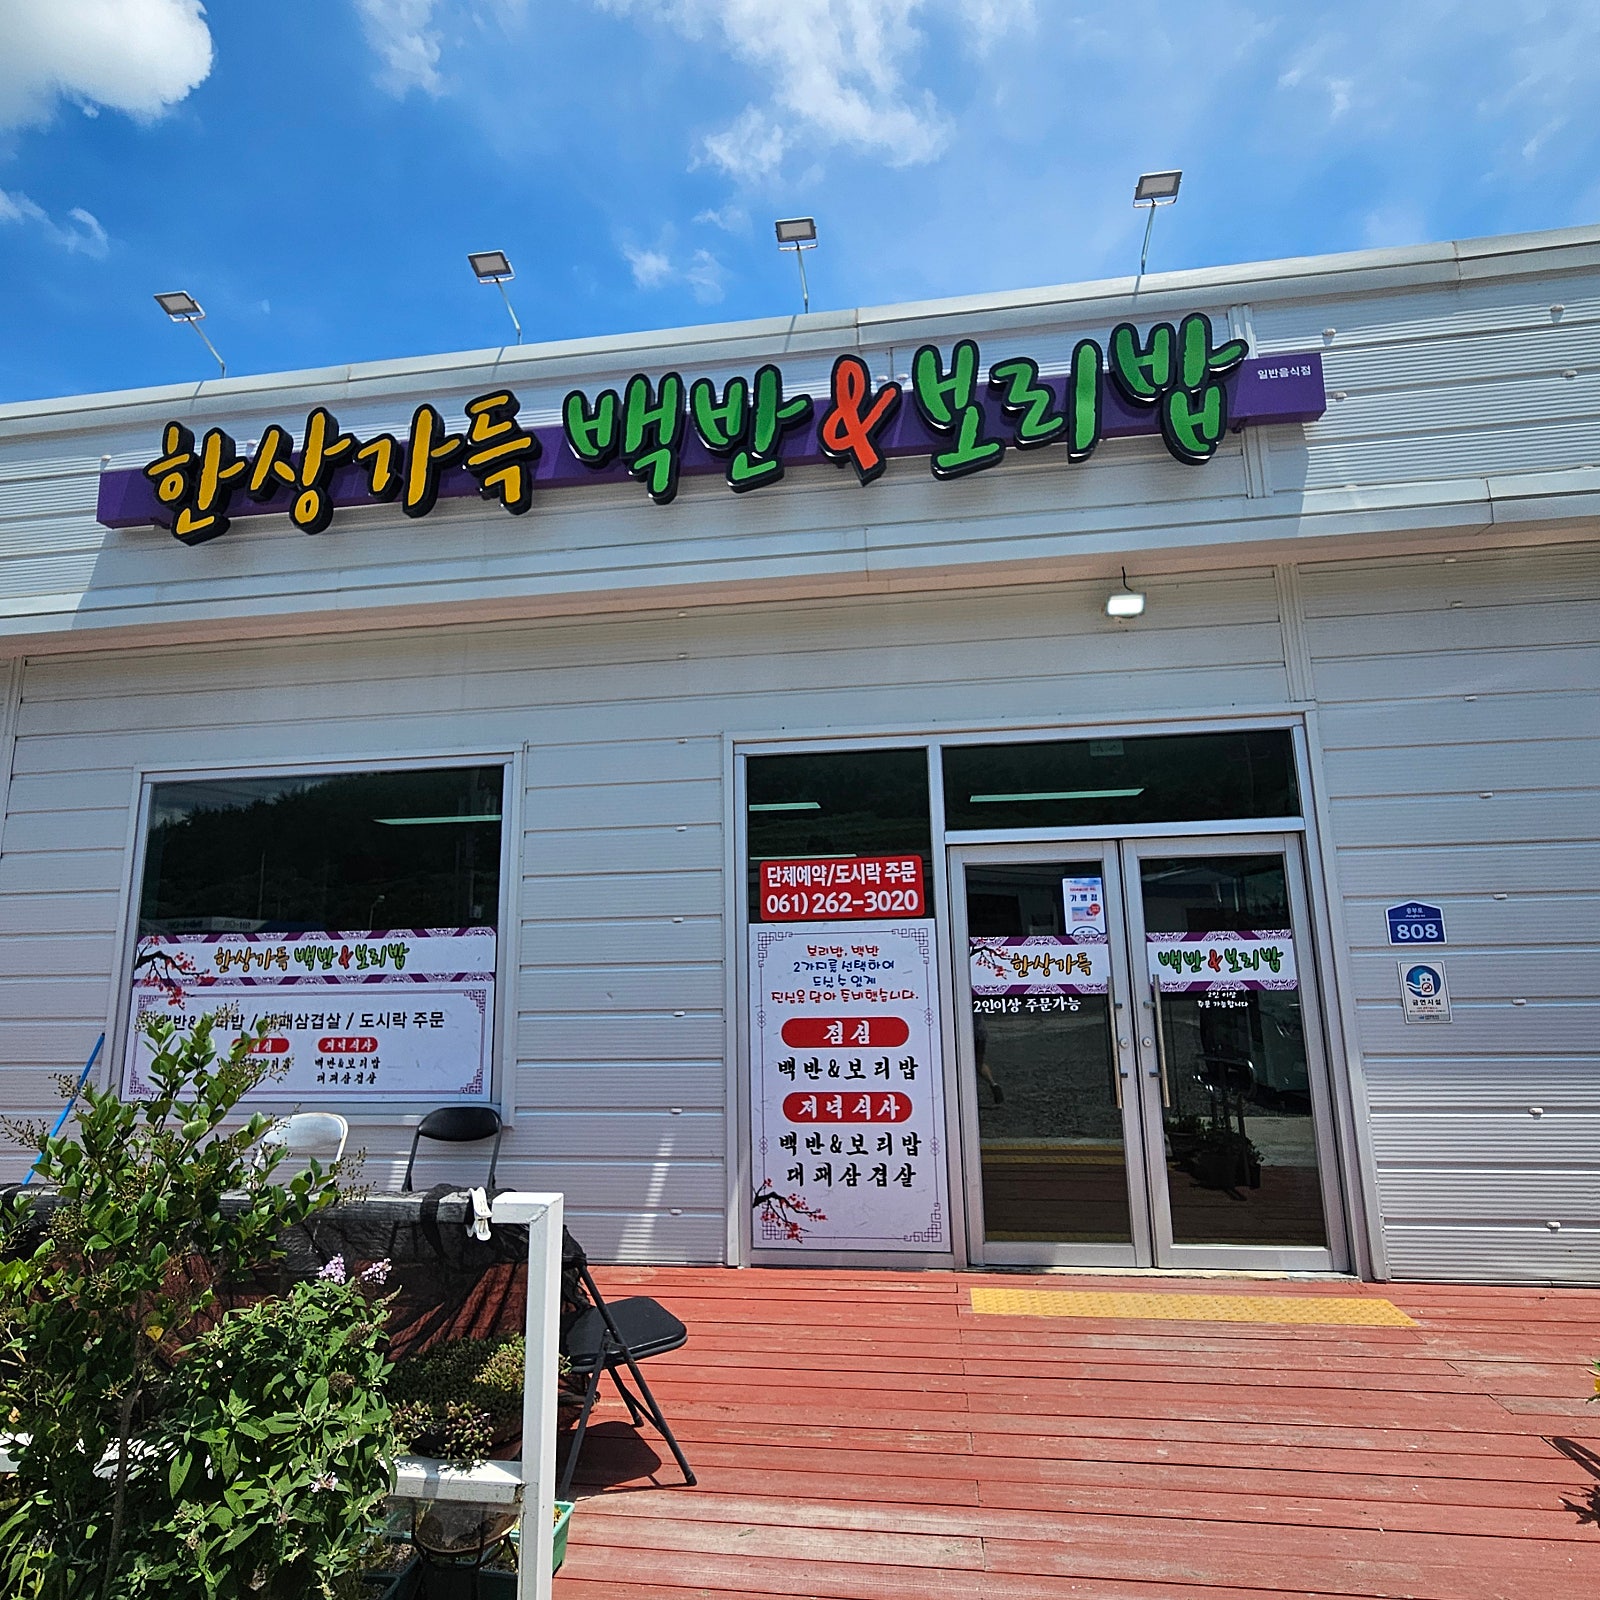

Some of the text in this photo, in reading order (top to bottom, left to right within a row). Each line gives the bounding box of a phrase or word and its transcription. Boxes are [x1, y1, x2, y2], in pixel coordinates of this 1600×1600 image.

[1257, 365, 1311, 380] 일반음식점
[144, 390, 540, 545] 한상가득
[767, 861, 917, 888] 단체예약/도시락 주문
[1397, 923, 1438, 939] 808
[214, 945, 290, 973] 한상가득
[851, 945, 880, 957] 백반
[793, 959, 895, 973] 2가지를 선택하여
[1010, 952, 1092, 977] 한상가득
[850, 975, 876, 988] 있게
[771, 989, 806, 1004] 진심을
[809, 991, 837, 1004] 담아
[973, 995, 1081, 1014] 2인이상 주문가능
[359, 1011, 408, 1029] 도시락
[412, 1010, 445, 1029] 주문
[823, 1020, 870, 1045] 점심
[797, 1093, 900, 1121] 저녁식사
[786, 1162, 917, 1188] 대패삼겹살
